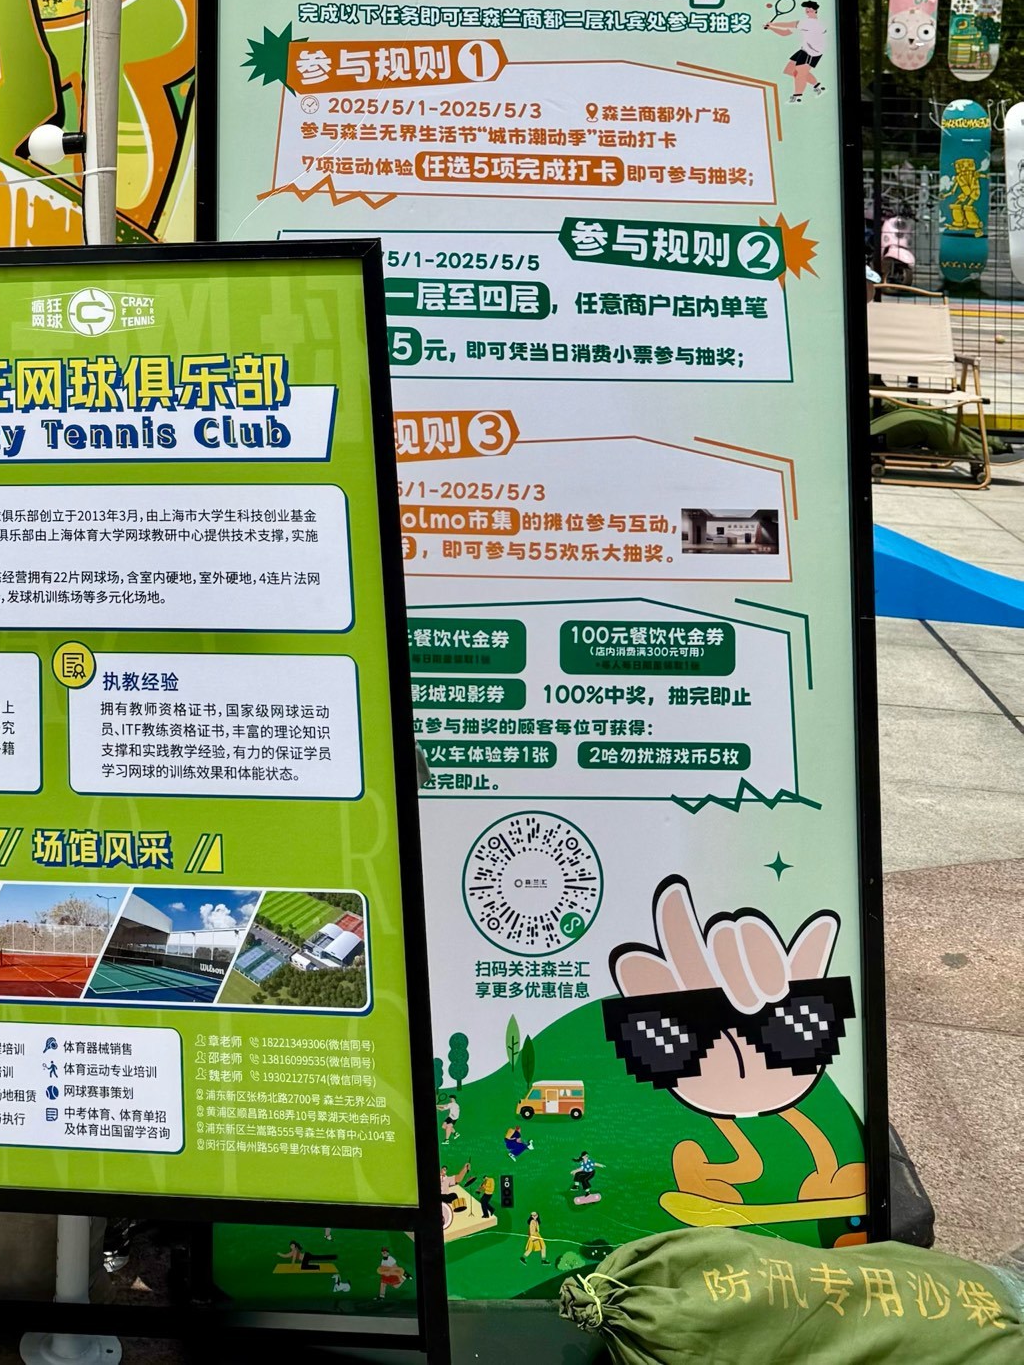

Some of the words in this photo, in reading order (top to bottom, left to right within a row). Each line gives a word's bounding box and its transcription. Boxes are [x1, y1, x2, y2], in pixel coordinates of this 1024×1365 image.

[298, 2, 752, 34] 完成以下任务即可至森兰商都二层礼宾处参与抽奖
[328, 98, 542, 119] 2025/5/1-2025/5/3
[602, 103, 731, 124] 森兰商都外广场
[381, 251, 540, 271] 5/1-2025/5/5
[32, 298, 63, 314] 疯狂
[121, 296, 154, 307] CRAZY
[32, 313, 63, 329] 网球
[121, 315, 155, 327] TENNIS
[43, 416, 177, 450] Tennis
[194, 416, 291, 449] Club
[571, 625, 725, 646] 100元餐饮代金券
[589, 646, 705, 658] （店内消费满300元可用）
[102, 671, 179, 692] 执教经验
[423, 745, 549, 763] 火车体验券1张
[589, 746, 740, 766] 2哈勿扰游戏币5枚
[101, 764, 300, 781] 学习网球的训练效果和体能状态。
[31, 830, 173, 871] 场馆风采
[199, 963, 225, 975] Wilson
[475, 960, 591, 979] 扫码关注森兰汇
[475, 981, 591, 1000] 享更多优惠信息
[63, 1040, 133, 1055] 体育器械销售
[208, 1035, 243, 1048] 章老师
[208, 1052, 243, 1065] 邵老师
[63, 1062, 157, 1079] 体育运动专业培训
[208, 1069, 243, 1083] 魏老师
[63, 1084, 134, 1100] 网球赛事策划
[206, 1090, 321, 1106] 浦东新区张杨北路2700号
[323, 1094, 387, 1108] 森兰无界公园
[64, 1106, 167, 1123] 中考体育、体育单招
[206, 1106, 391, 1126] 黄浦区顺昌路168弄10号翠湖天地会所内
[64, 1124, 171, 1140] 及体育出国留学咨询
[702, 1257, 1007, 1330] 防汛专用沙袋
